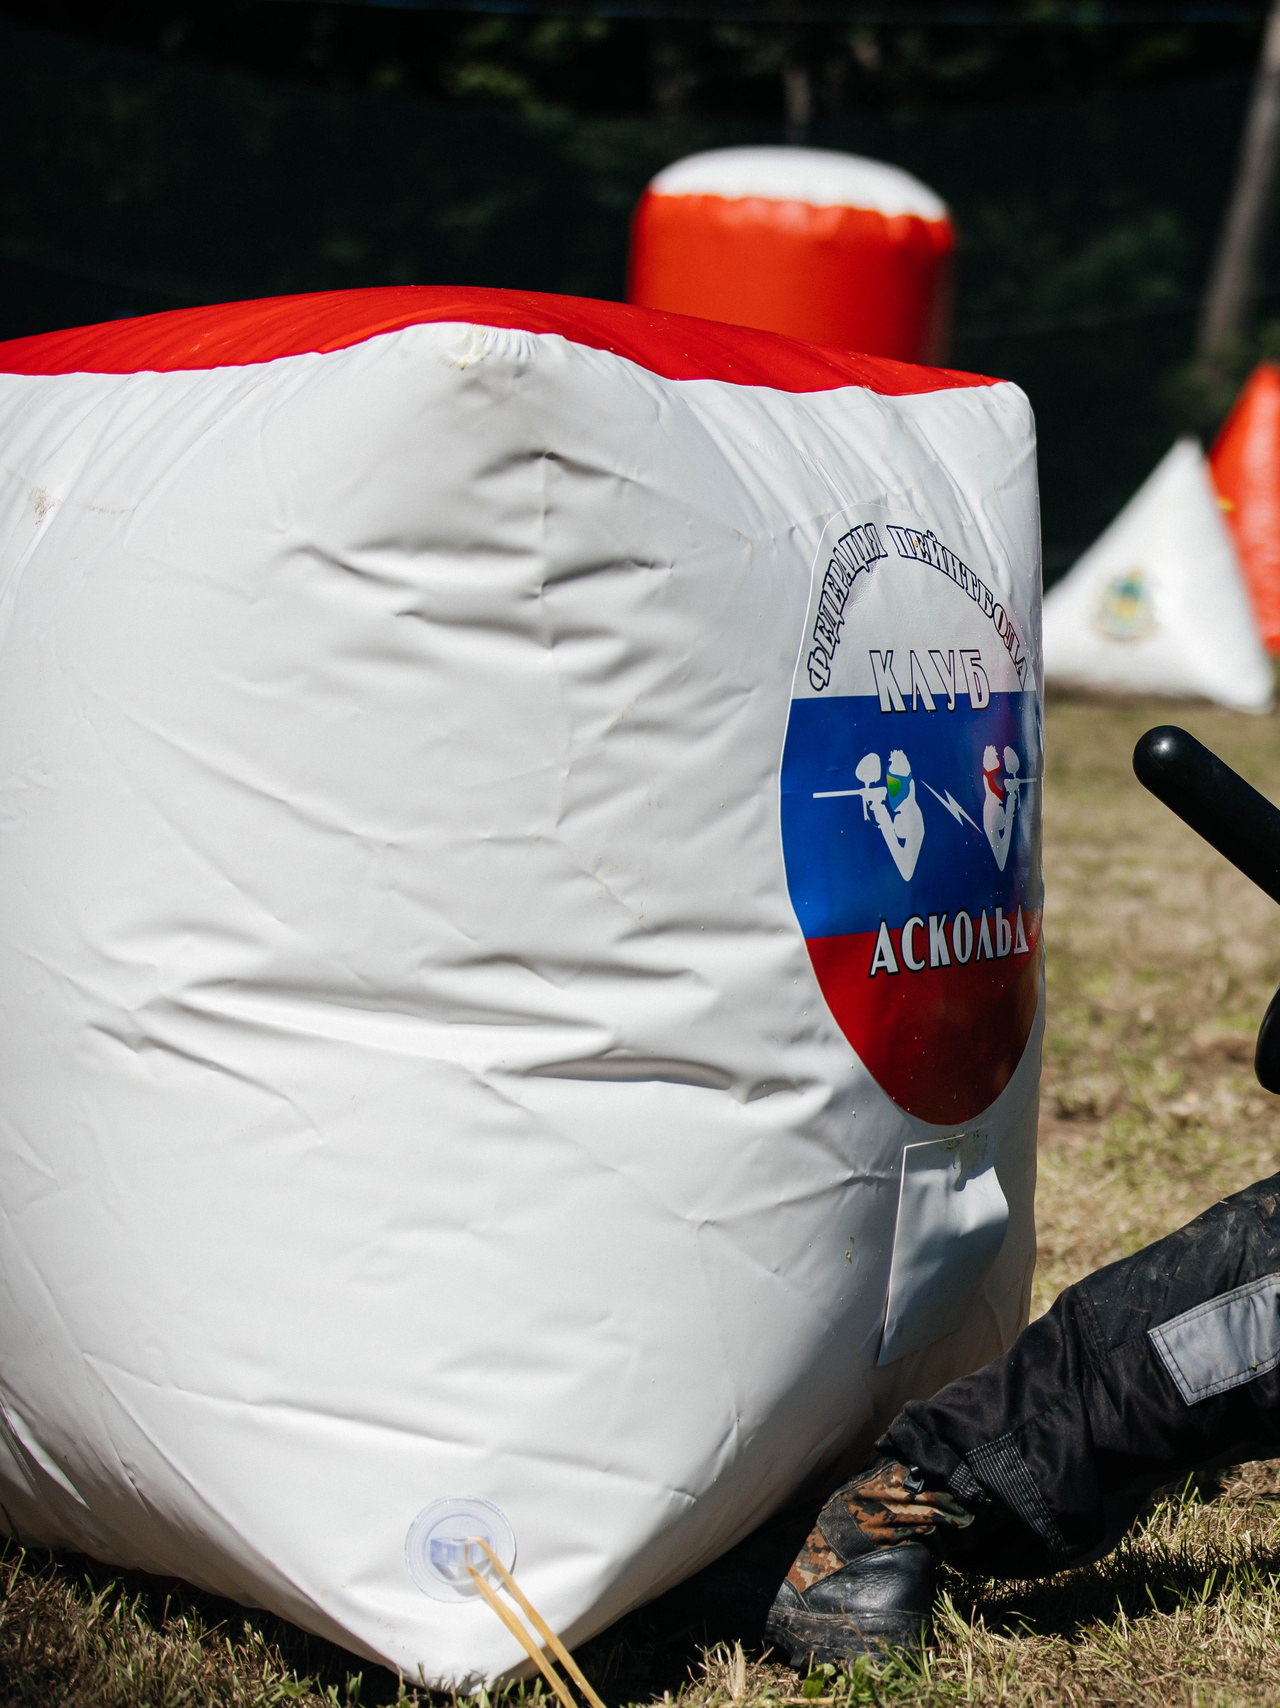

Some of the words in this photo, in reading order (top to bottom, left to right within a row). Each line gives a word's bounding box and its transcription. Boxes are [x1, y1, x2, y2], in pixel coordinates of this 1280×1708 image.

[807, 523, 889, 691] ФЕДЕРАЦИЯ
[886, 525, 1028, 691] ПЕЙНТБОЛА
[869, 649, 990, 713] КЛУБ
[868, 904, 1029, 978] АСКОЛЬД
